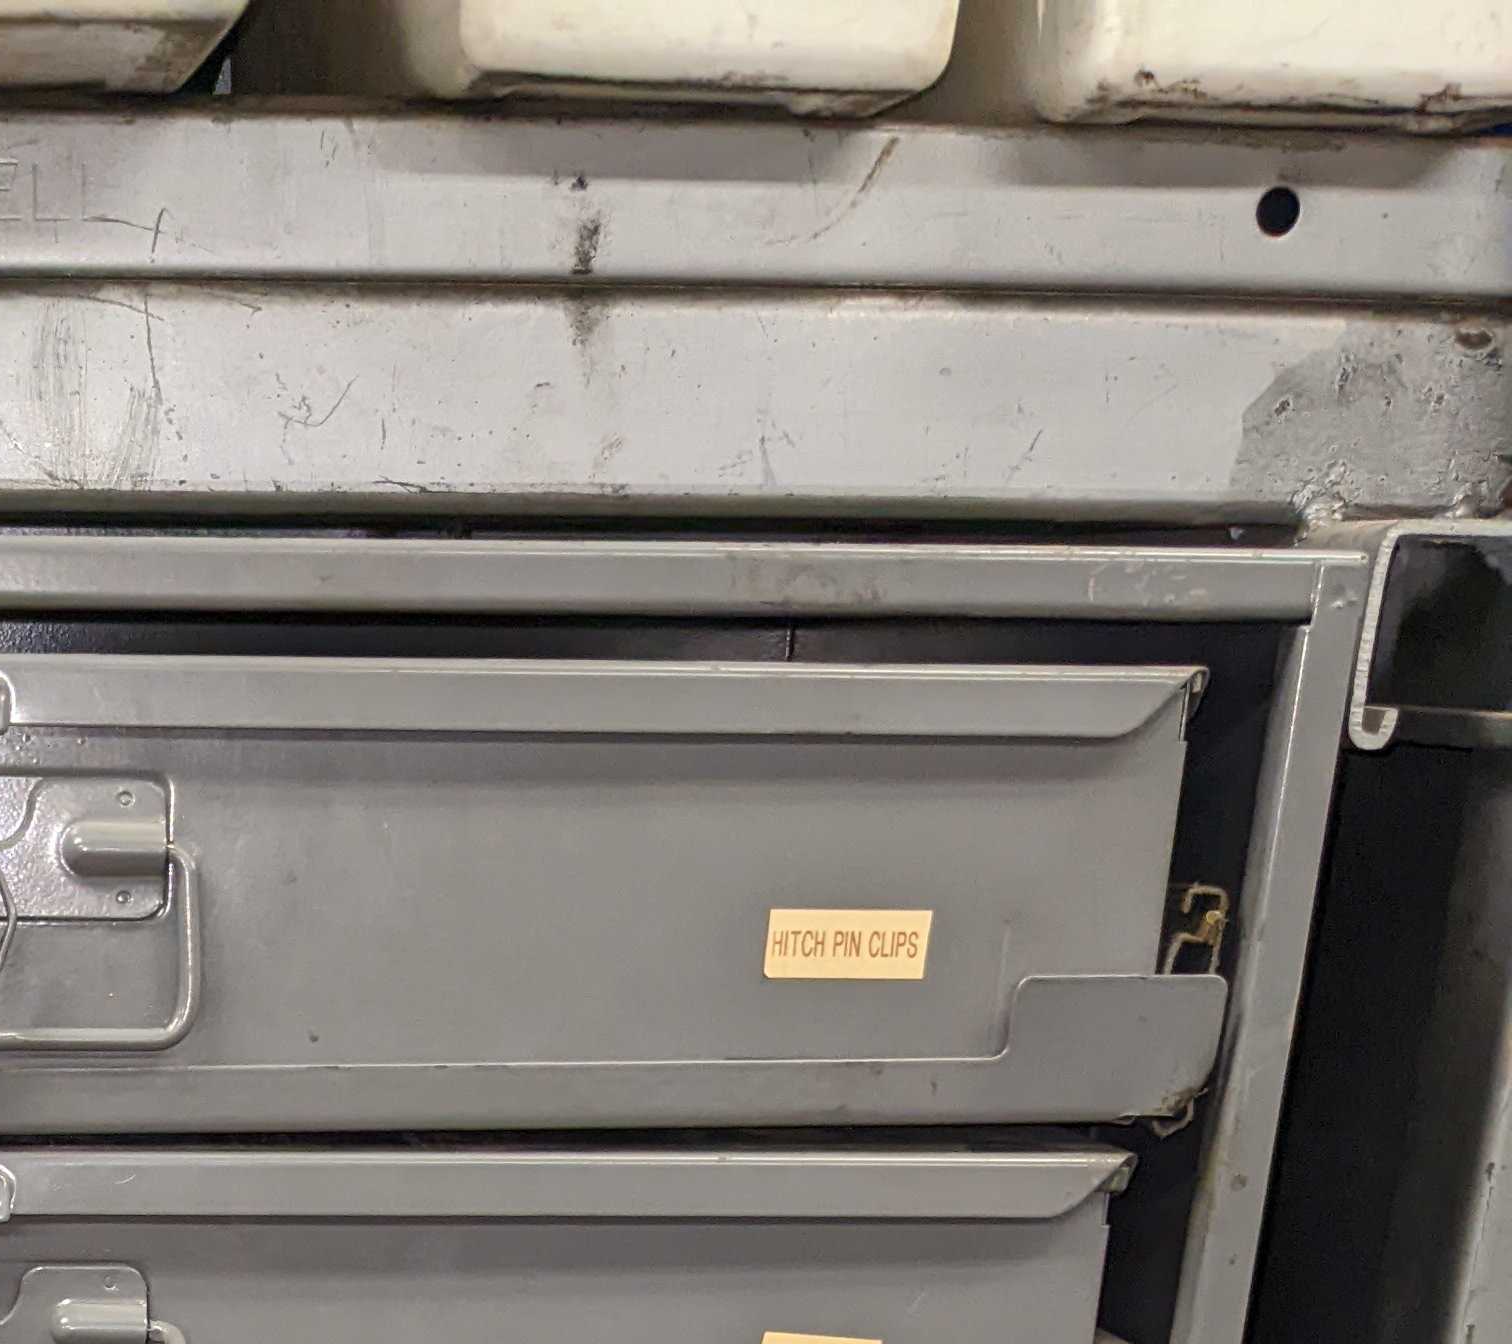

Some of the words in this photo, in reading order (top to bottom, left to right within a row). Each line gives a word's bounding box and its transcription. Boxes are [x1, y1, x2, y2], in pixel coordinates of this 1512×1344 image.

[771, 930, 826, 957] HITCH
[832, 930, 862, 957] PIN
[868, 931, 920, 959] CLIPS
